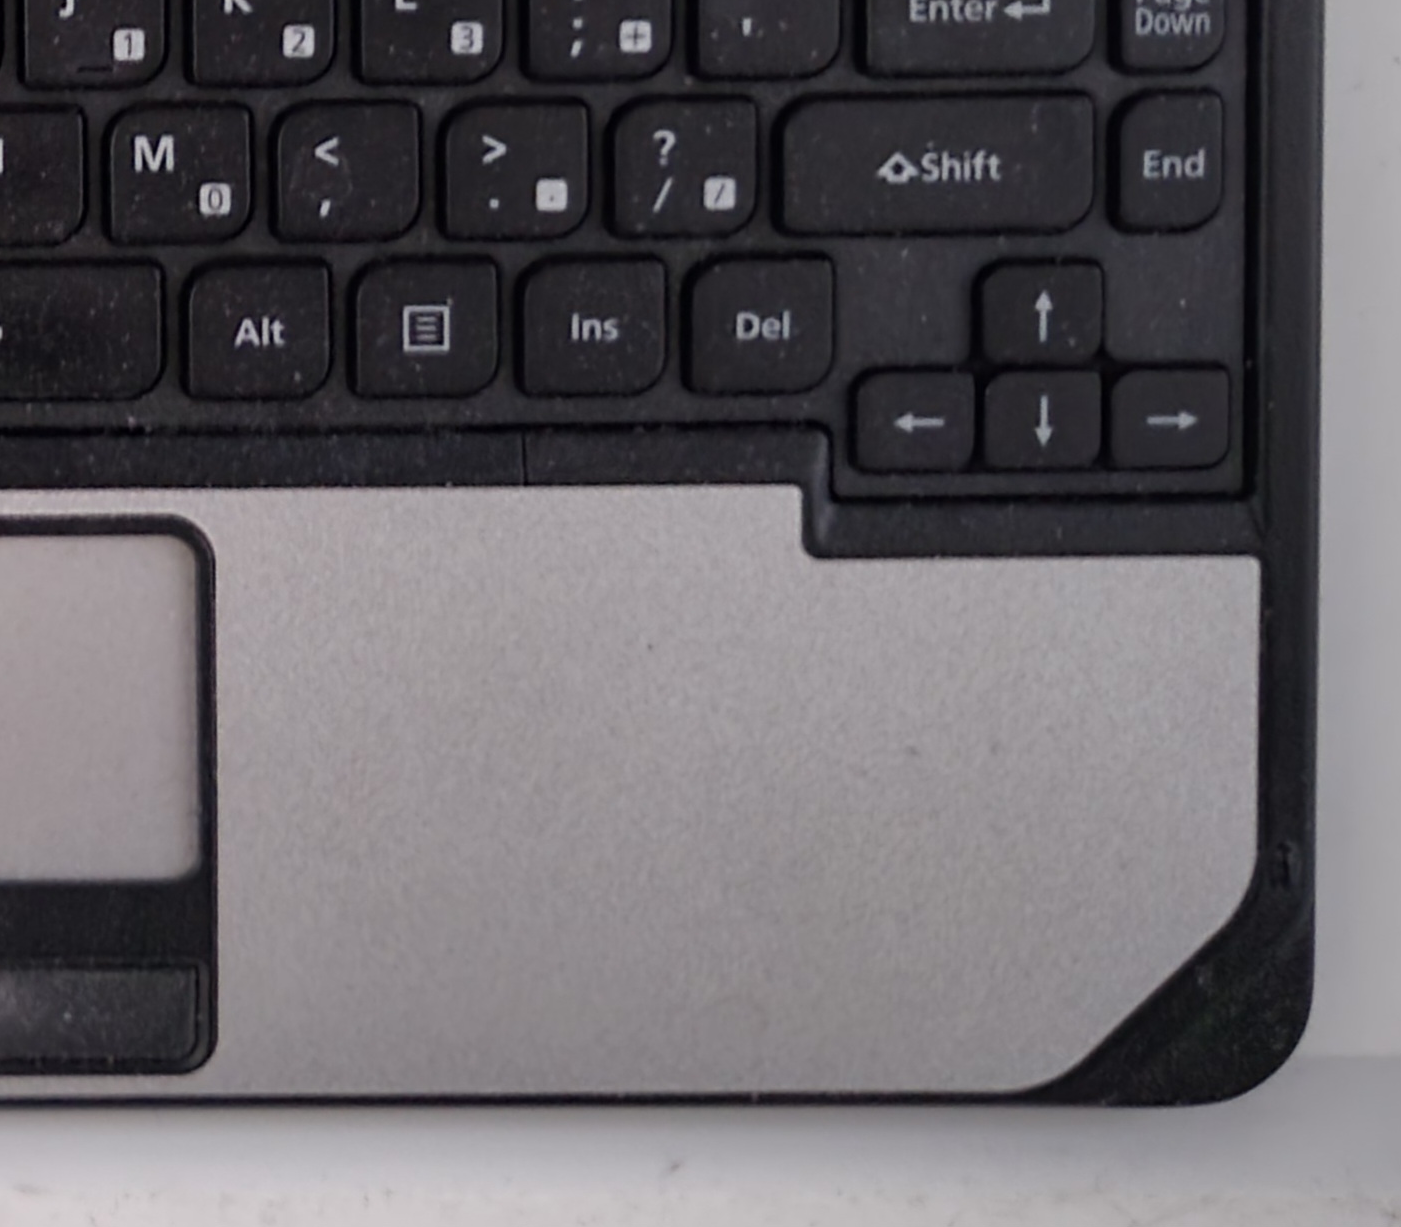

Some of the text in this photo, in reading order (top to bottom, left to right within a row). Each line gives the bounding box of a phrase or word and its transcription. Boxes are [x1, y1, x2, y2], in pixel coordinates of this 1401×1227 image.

[1136, 8, 1210, 35] Down
[135, 136, 174, 171] M
[315, 138, 338, 165] <
[483, 136, 506, 163] >
[654, 130, 675, 165] ?
[922, 151, 1000, 181] Shift
[1143, 149, 1205, 178] End
[654, 178, 672, 212] /
[235, 317, 284, 346] Alt
[572, 313, 618, 341] Ins
[737, 311, 790, 340] Del
